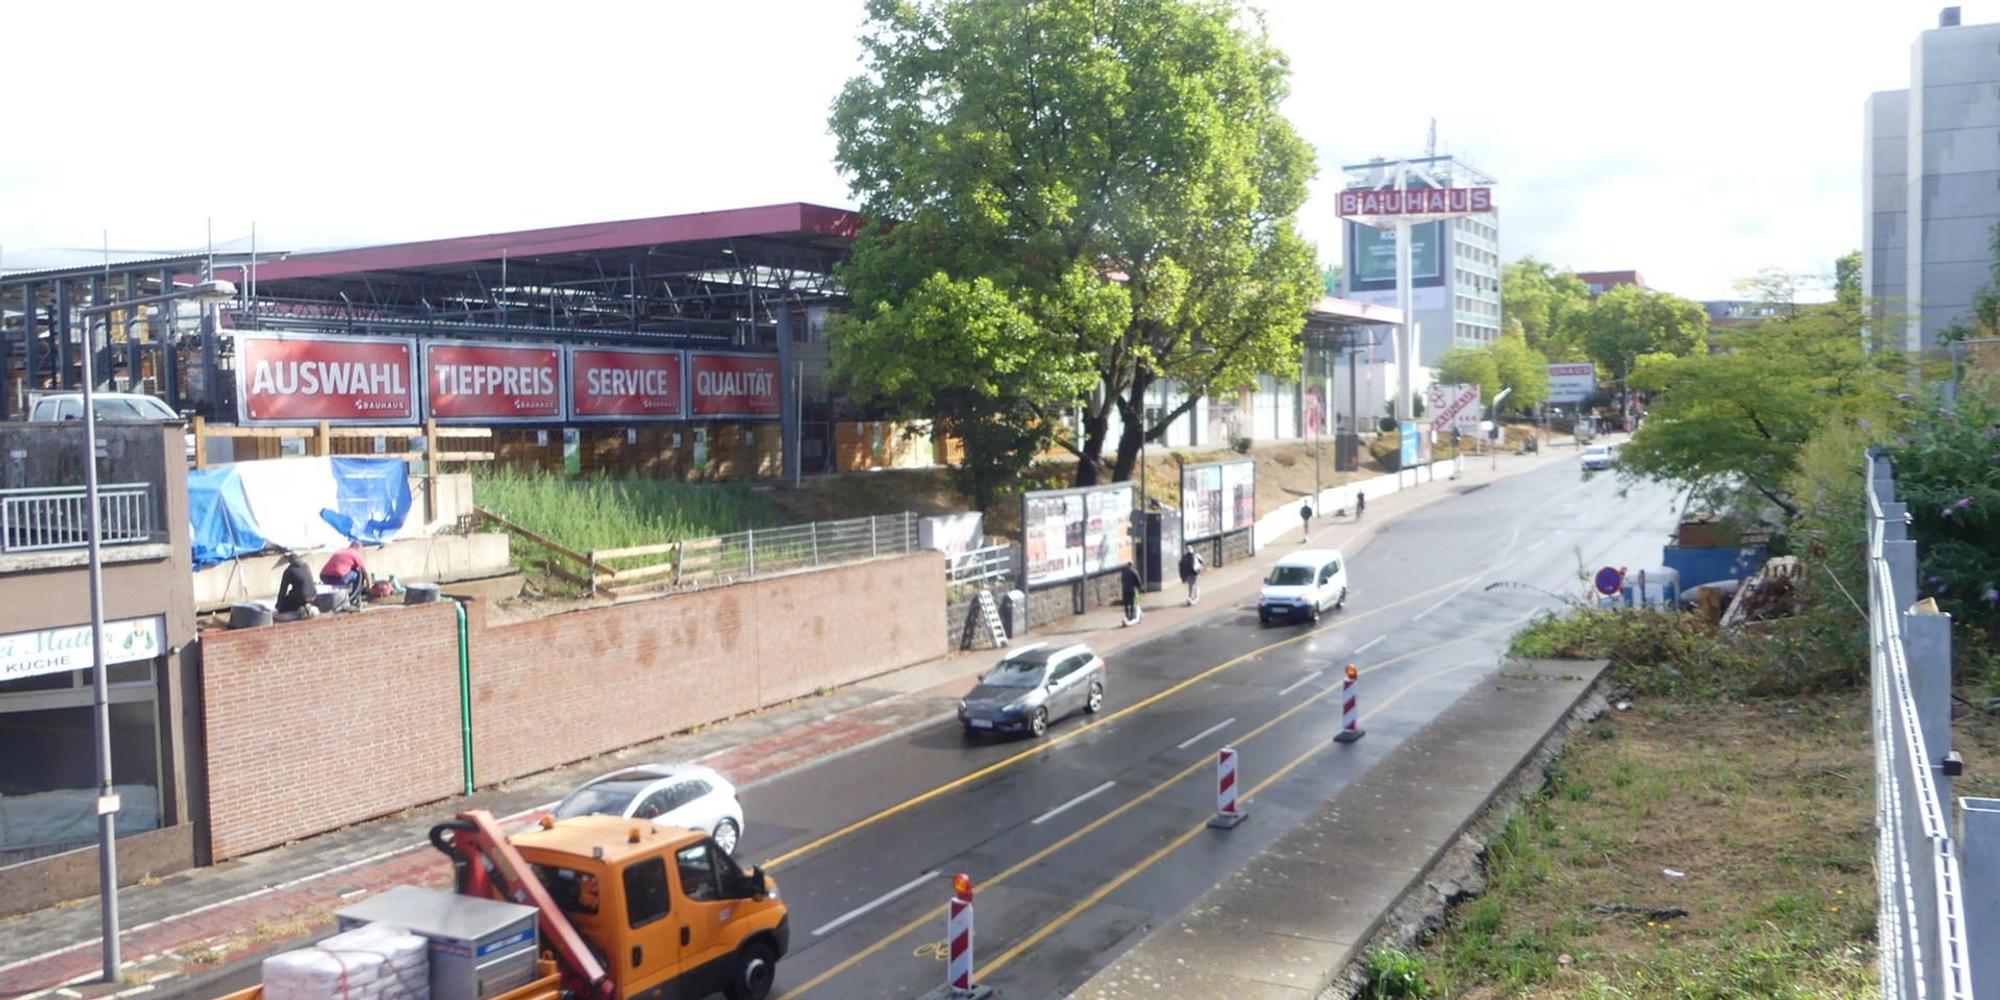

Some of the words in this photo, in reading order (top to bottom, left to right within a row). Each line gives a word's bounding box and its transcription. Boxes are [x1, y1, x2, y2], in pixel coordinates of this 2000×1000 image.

[1342, 191, 1488, 213] BAUHAUS
[252, 360, 406, 396] AUSWAHL
[434, 364, 554, 396] TIEFPREIS
[586, 367, 668, 396] SERVICE
[697, 367, 774, 396] QUALITÄT
[362, 400, 405, 410] BAUHAUS
